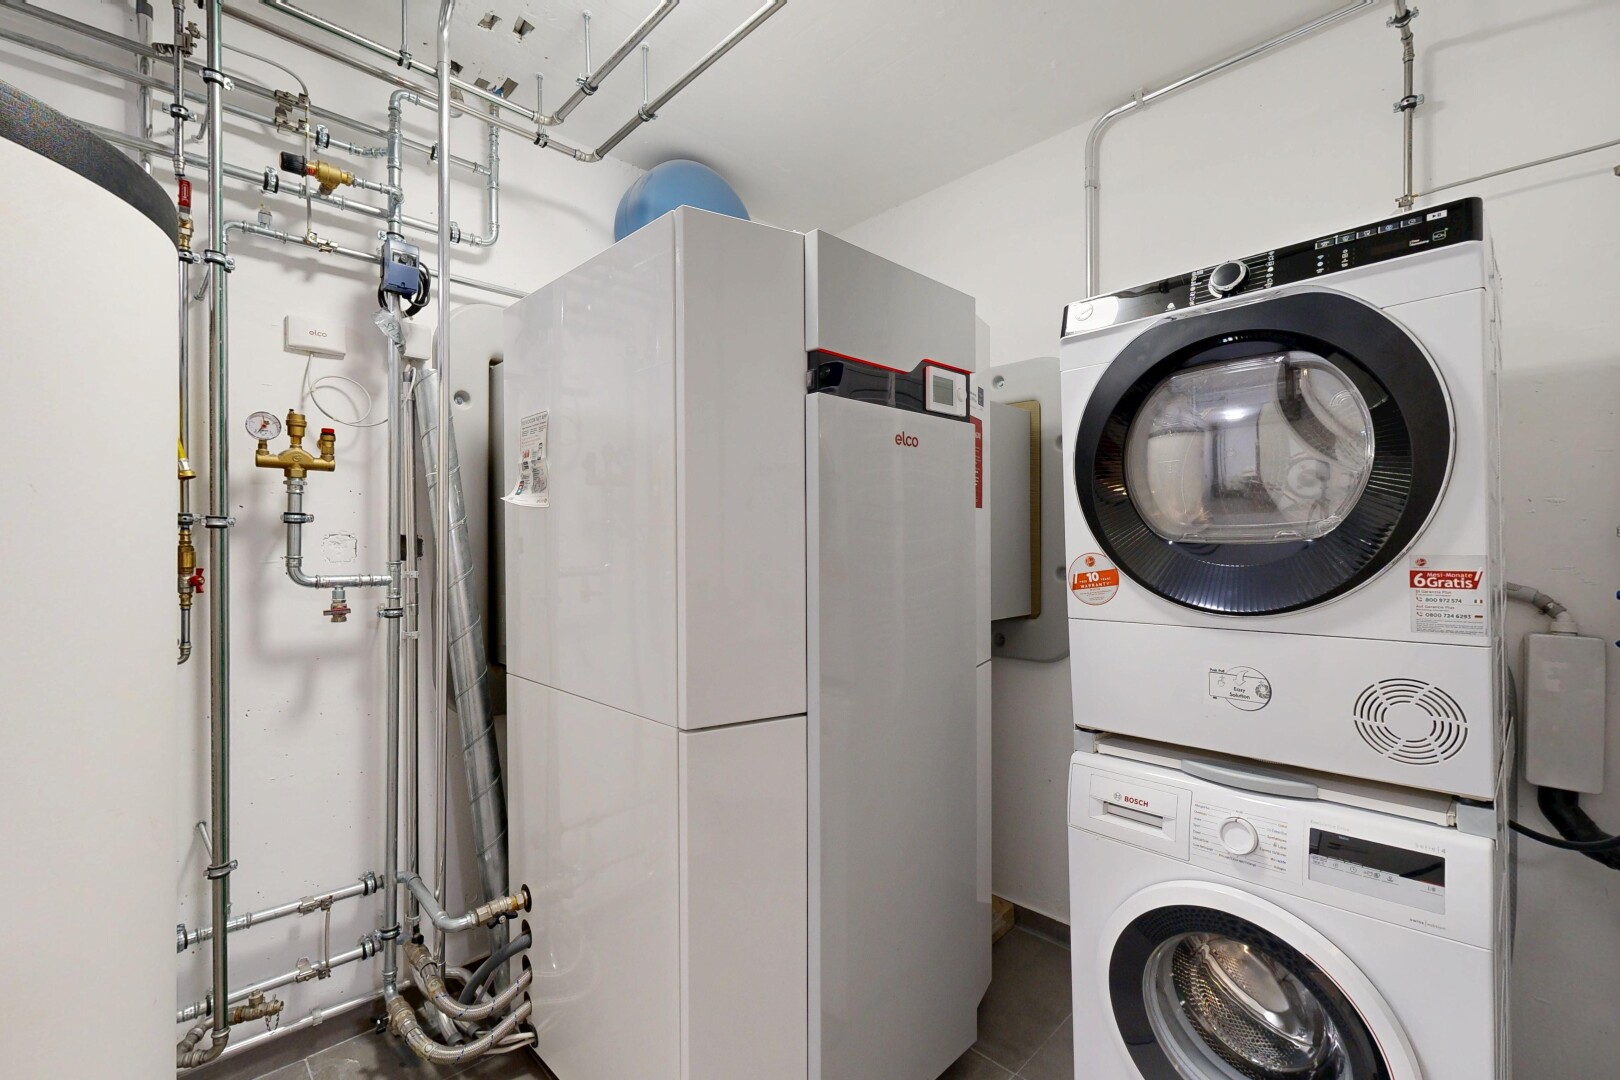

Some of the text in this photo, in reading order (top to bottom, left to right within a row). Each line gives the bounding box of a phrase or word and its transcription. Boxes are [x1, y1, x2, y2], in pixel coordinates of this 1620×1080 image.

[308, 329, 328, 338] elco
[895, 431, 919, 448] elco
[1086, 571, 1100, 583] 10
[1229, 691, 1251, 700] Solution
[1124, 795, 1149, 808] BOSCH
